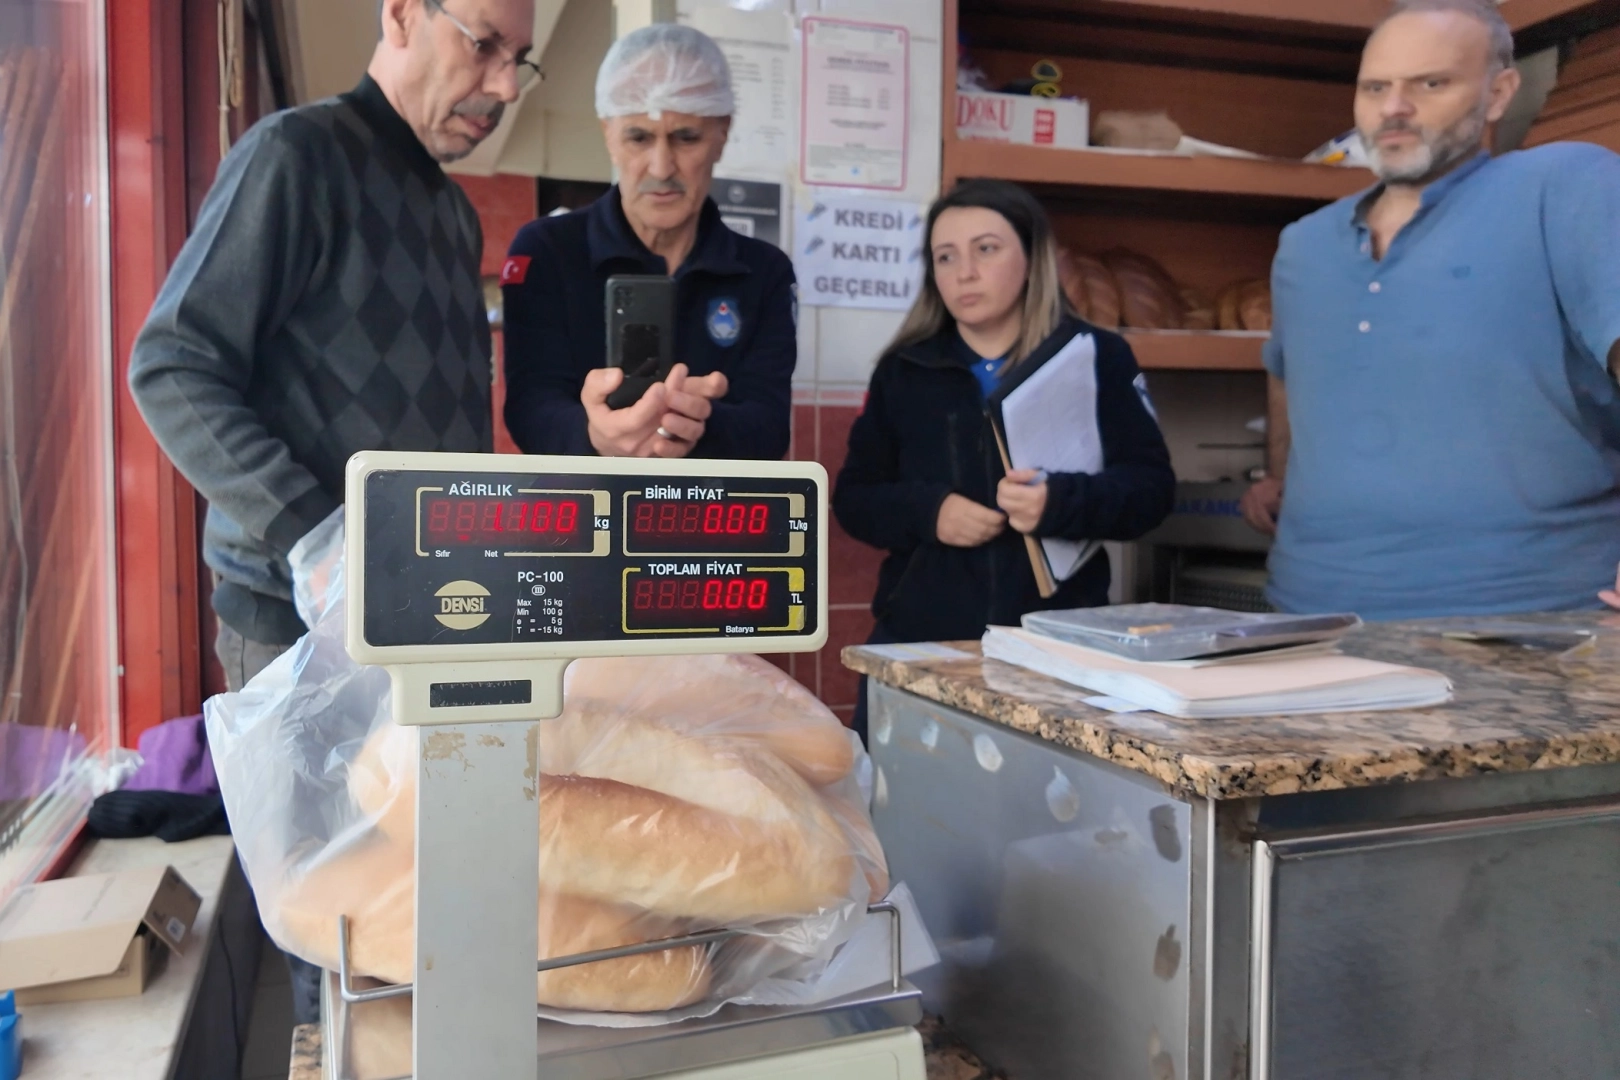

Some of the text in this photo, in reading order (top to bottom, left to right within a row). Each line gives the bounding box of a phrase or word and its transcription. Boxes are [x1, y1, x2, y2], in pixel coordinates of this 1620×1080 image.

[834, 208, 903, 231] KREDİ
[832, 242, 901, 263] KARTI
[814, 276, 910, 300] GEÇERLİ
[448, 480, 513, 496] AĞIRLIK
[645, 485, 724, 500] BİRİM FİYAT
[594, 517, 609, 529] kg
[789, 520, 808, 531] TL/kg
[648, 561, 743, 575] TOPLAM FİYAT
[517, 571, 564, 583] PC-100
[553, 599, 563, 608] kg
[791, 593, 802, 603] TL
[557, 618, 563, 626] g
[553, 627, 563, 635] kg
[725, 625, 754, 634] Batarya
